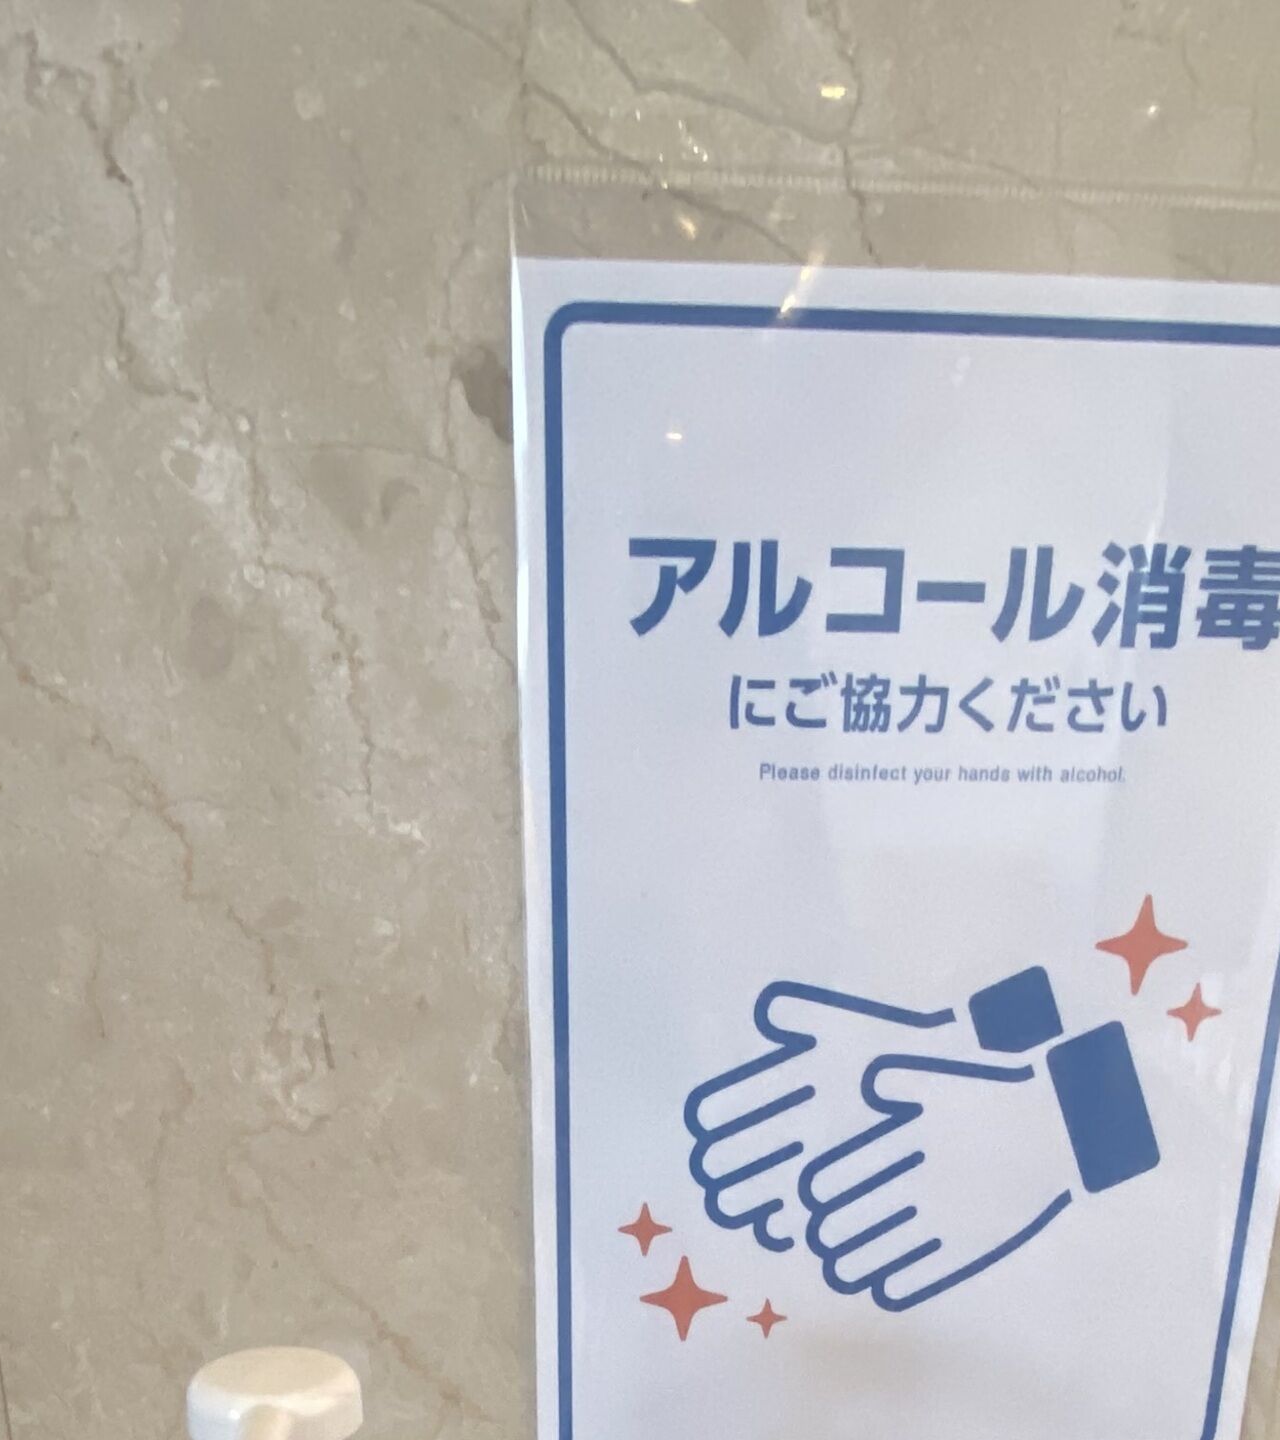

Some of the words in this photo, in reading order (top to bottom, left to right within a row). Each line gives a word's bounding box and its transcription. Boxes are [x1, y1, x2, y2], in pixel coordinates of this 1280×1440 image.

[729, 672, 1168, 735] にご協力ください
[759, 763, 820, 781] Please
[827, 764, 907, 782] disinfect
[913, 769, 952, 785] your
[957, 765, 1011, 782] hands
[1017, 766, 1053, 783] with
